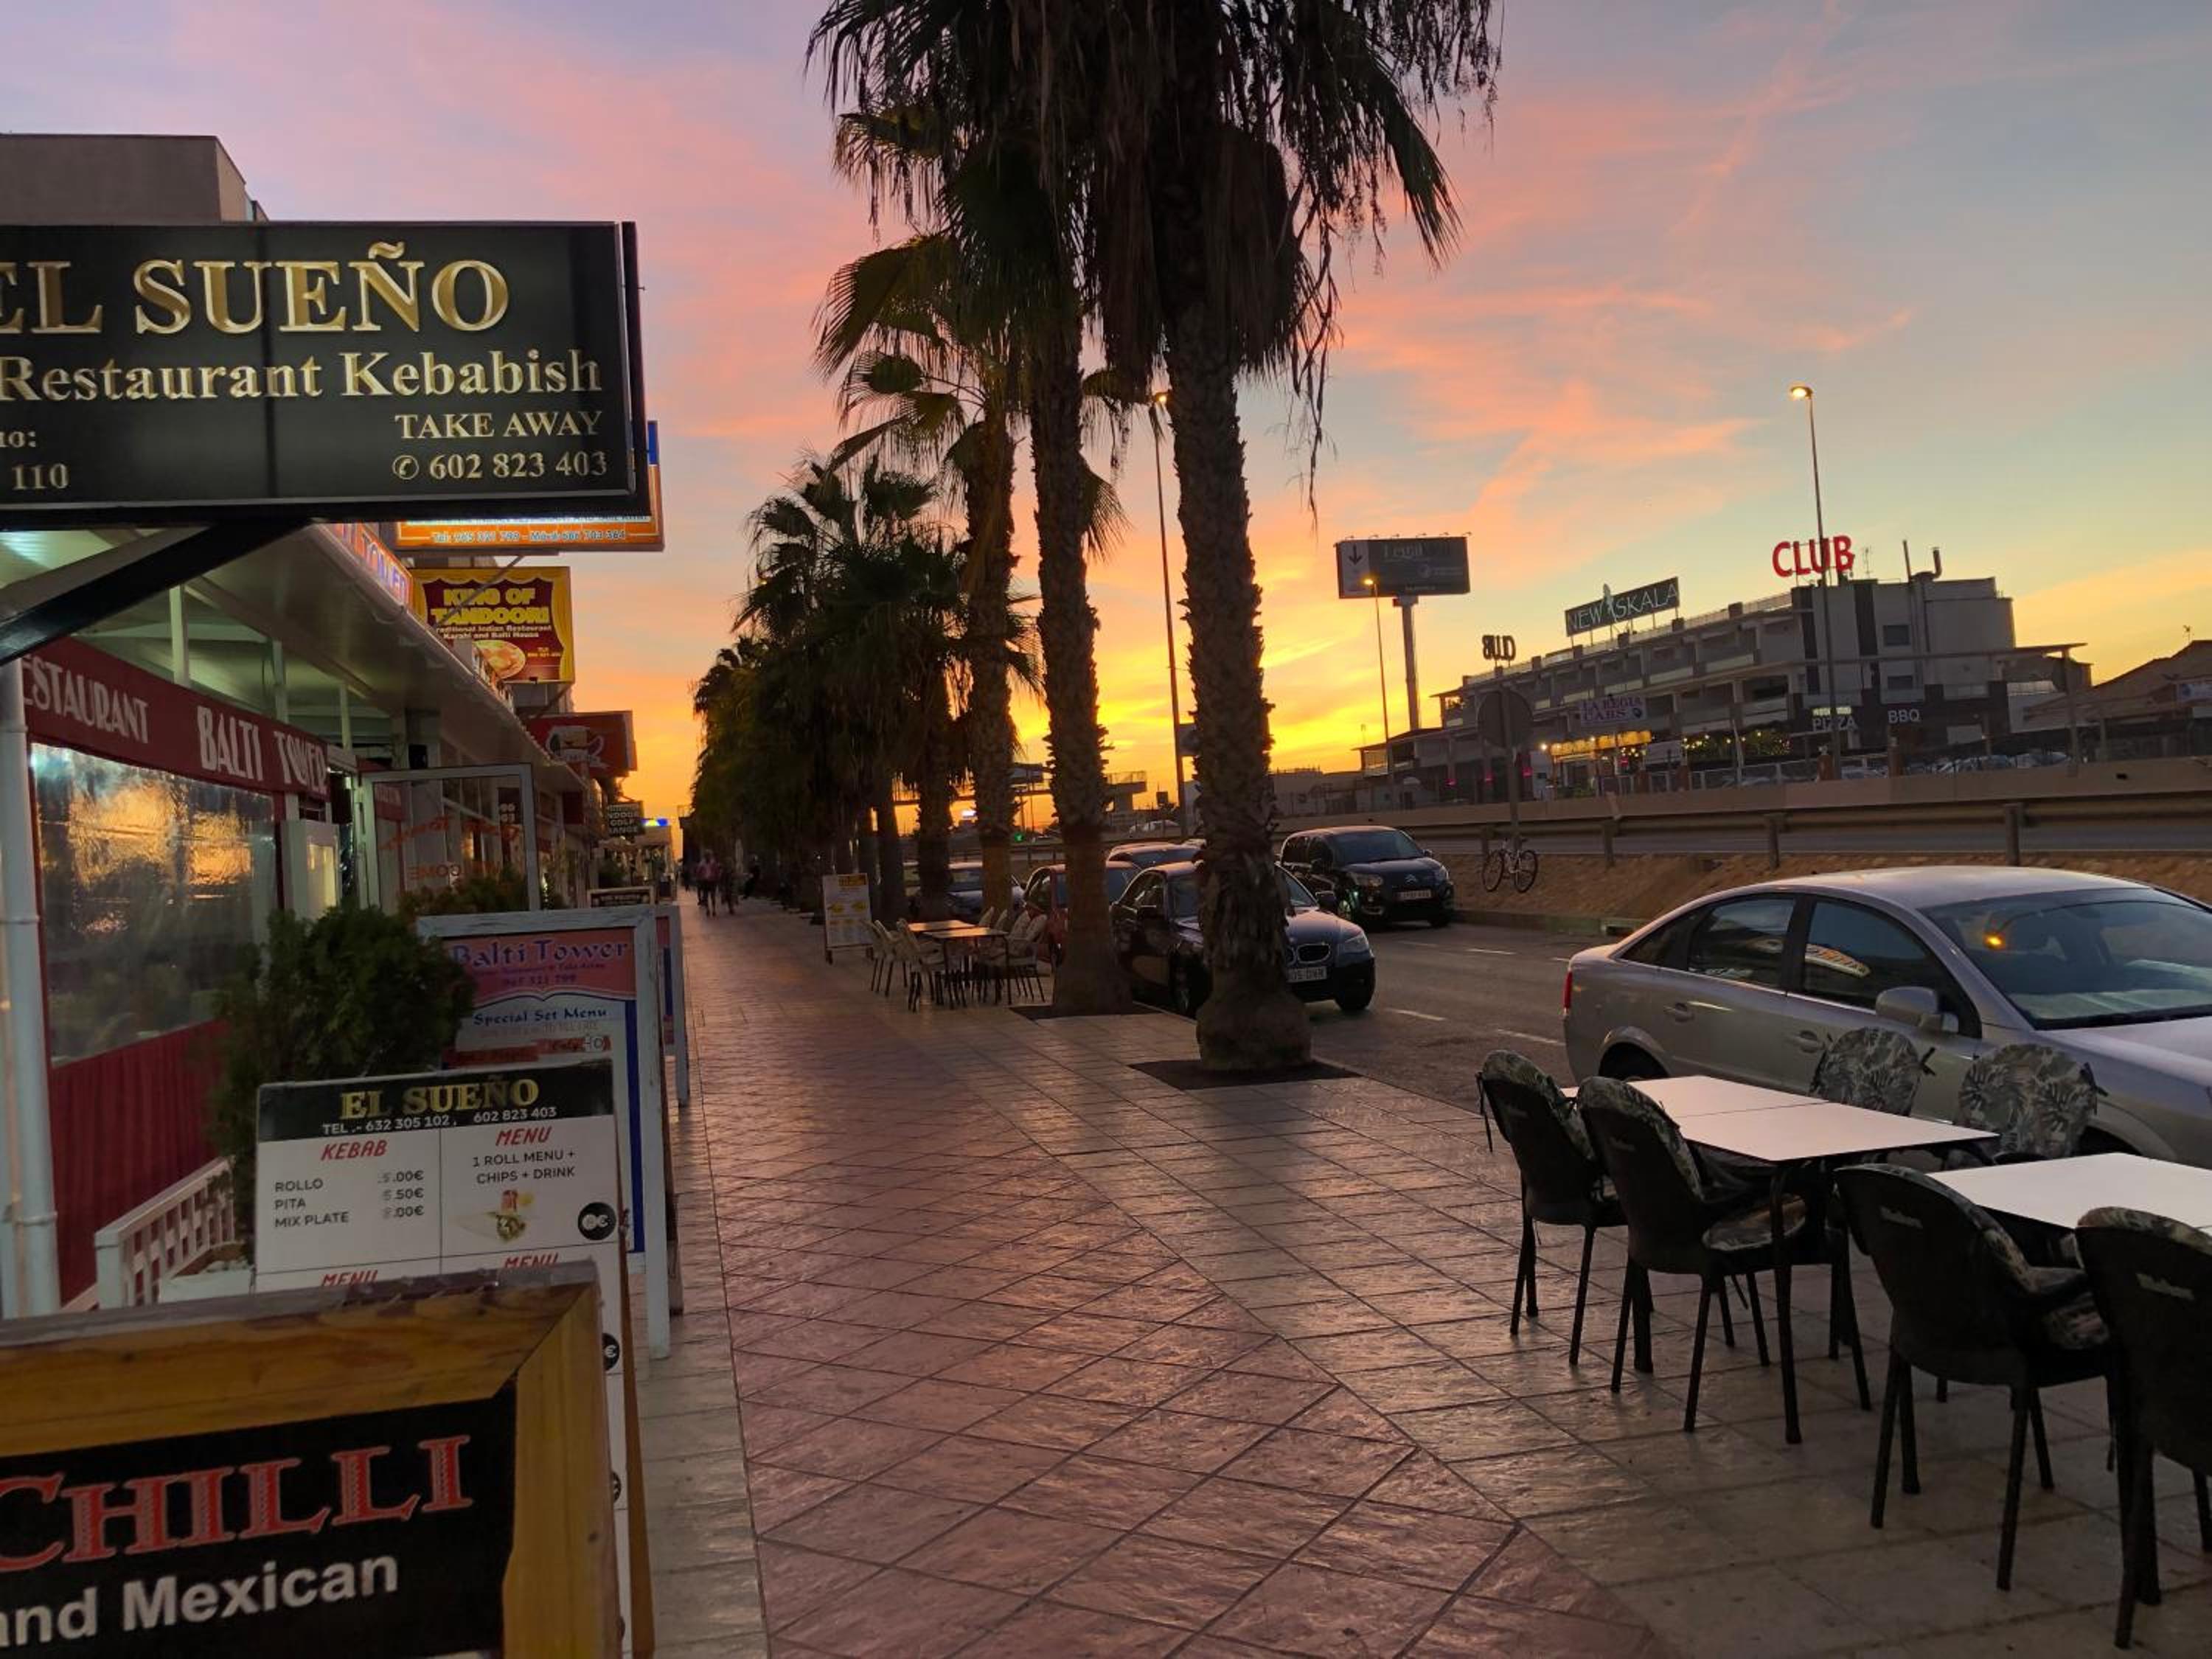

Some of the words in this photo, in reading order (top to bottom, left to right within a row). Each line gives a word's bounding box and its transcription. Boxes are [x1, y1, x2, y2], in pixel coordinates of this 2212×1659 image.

[133, 241, 510, 335] SUEÑO
[0, 356, 323, 402] Restaurant
[340, 349, 602, 397] Kebabish
[395, 414, 495, 440] TAKE
[504, 411, 602, 438] AWAY
[12, 463, 69, 490] 110
[430, 454, 482, 479] 602
[493, 453, 544, 478] 823
[556, 450, 607, 476] 403
[1773, 534, 1855, 579] CLUB
[443, 588, 501, 605] KING
[506, 588, 536, 605] OF
[1567, 601, 1604, 631] NEW
[1615, 580, 1679, 624] SKALA
[431, 606, 551, 625] TANDOORI
[436, 625, 476, 633] raditional
[22, 653, 148, 743] ESTAURANT
[196, 705, 264, 782] BALTI
[273, 730, 328, 796] TOWER
[1888, 709, 1921, 724] BBQ
[453, 941, 526, 967] Balti
[533, 939, 627, 961] Tower
[473, 1008, 527, 1026] Special
[534, 1009, 557, 1021] Set
[563, 1007, 608, 1019] Menu
[339, 1089, 393, 1121] EL
[403, 1075, 539, 1116] SUEÑO
[365, 1118, 392, 1132] 632
[394, 1116, 421, 1130] 305
[473, 1110, 500, 1124] 602
[502, 1107, 529, 1121] 823
[532, 1106, 557, 1119] 403
[495, 1126, 553, 1147] MENU
[320, 1138, 389, 1162] KEBAB
[484, 1153, 520, 1166] ROLL
[524, 1150, 565, 1164] MENU
[274, 1178, 324, 1192] ROLLO
[476, 1171, 518, 1184] CHIPS
[532, 1166, 576, 1180] DRINK
[274, 1197, 307, 1211] PITA
[274, 1214, 302, 1228] MIX
[304, 1210, 350, 1225] PLATE
[504, 1253, 559, 1269] MENU
[321, 1269, 379, 1287] MENU
[0, 1434, 473, 1573] CHILLI
[122, 1555, 399, 1632] Mexican
